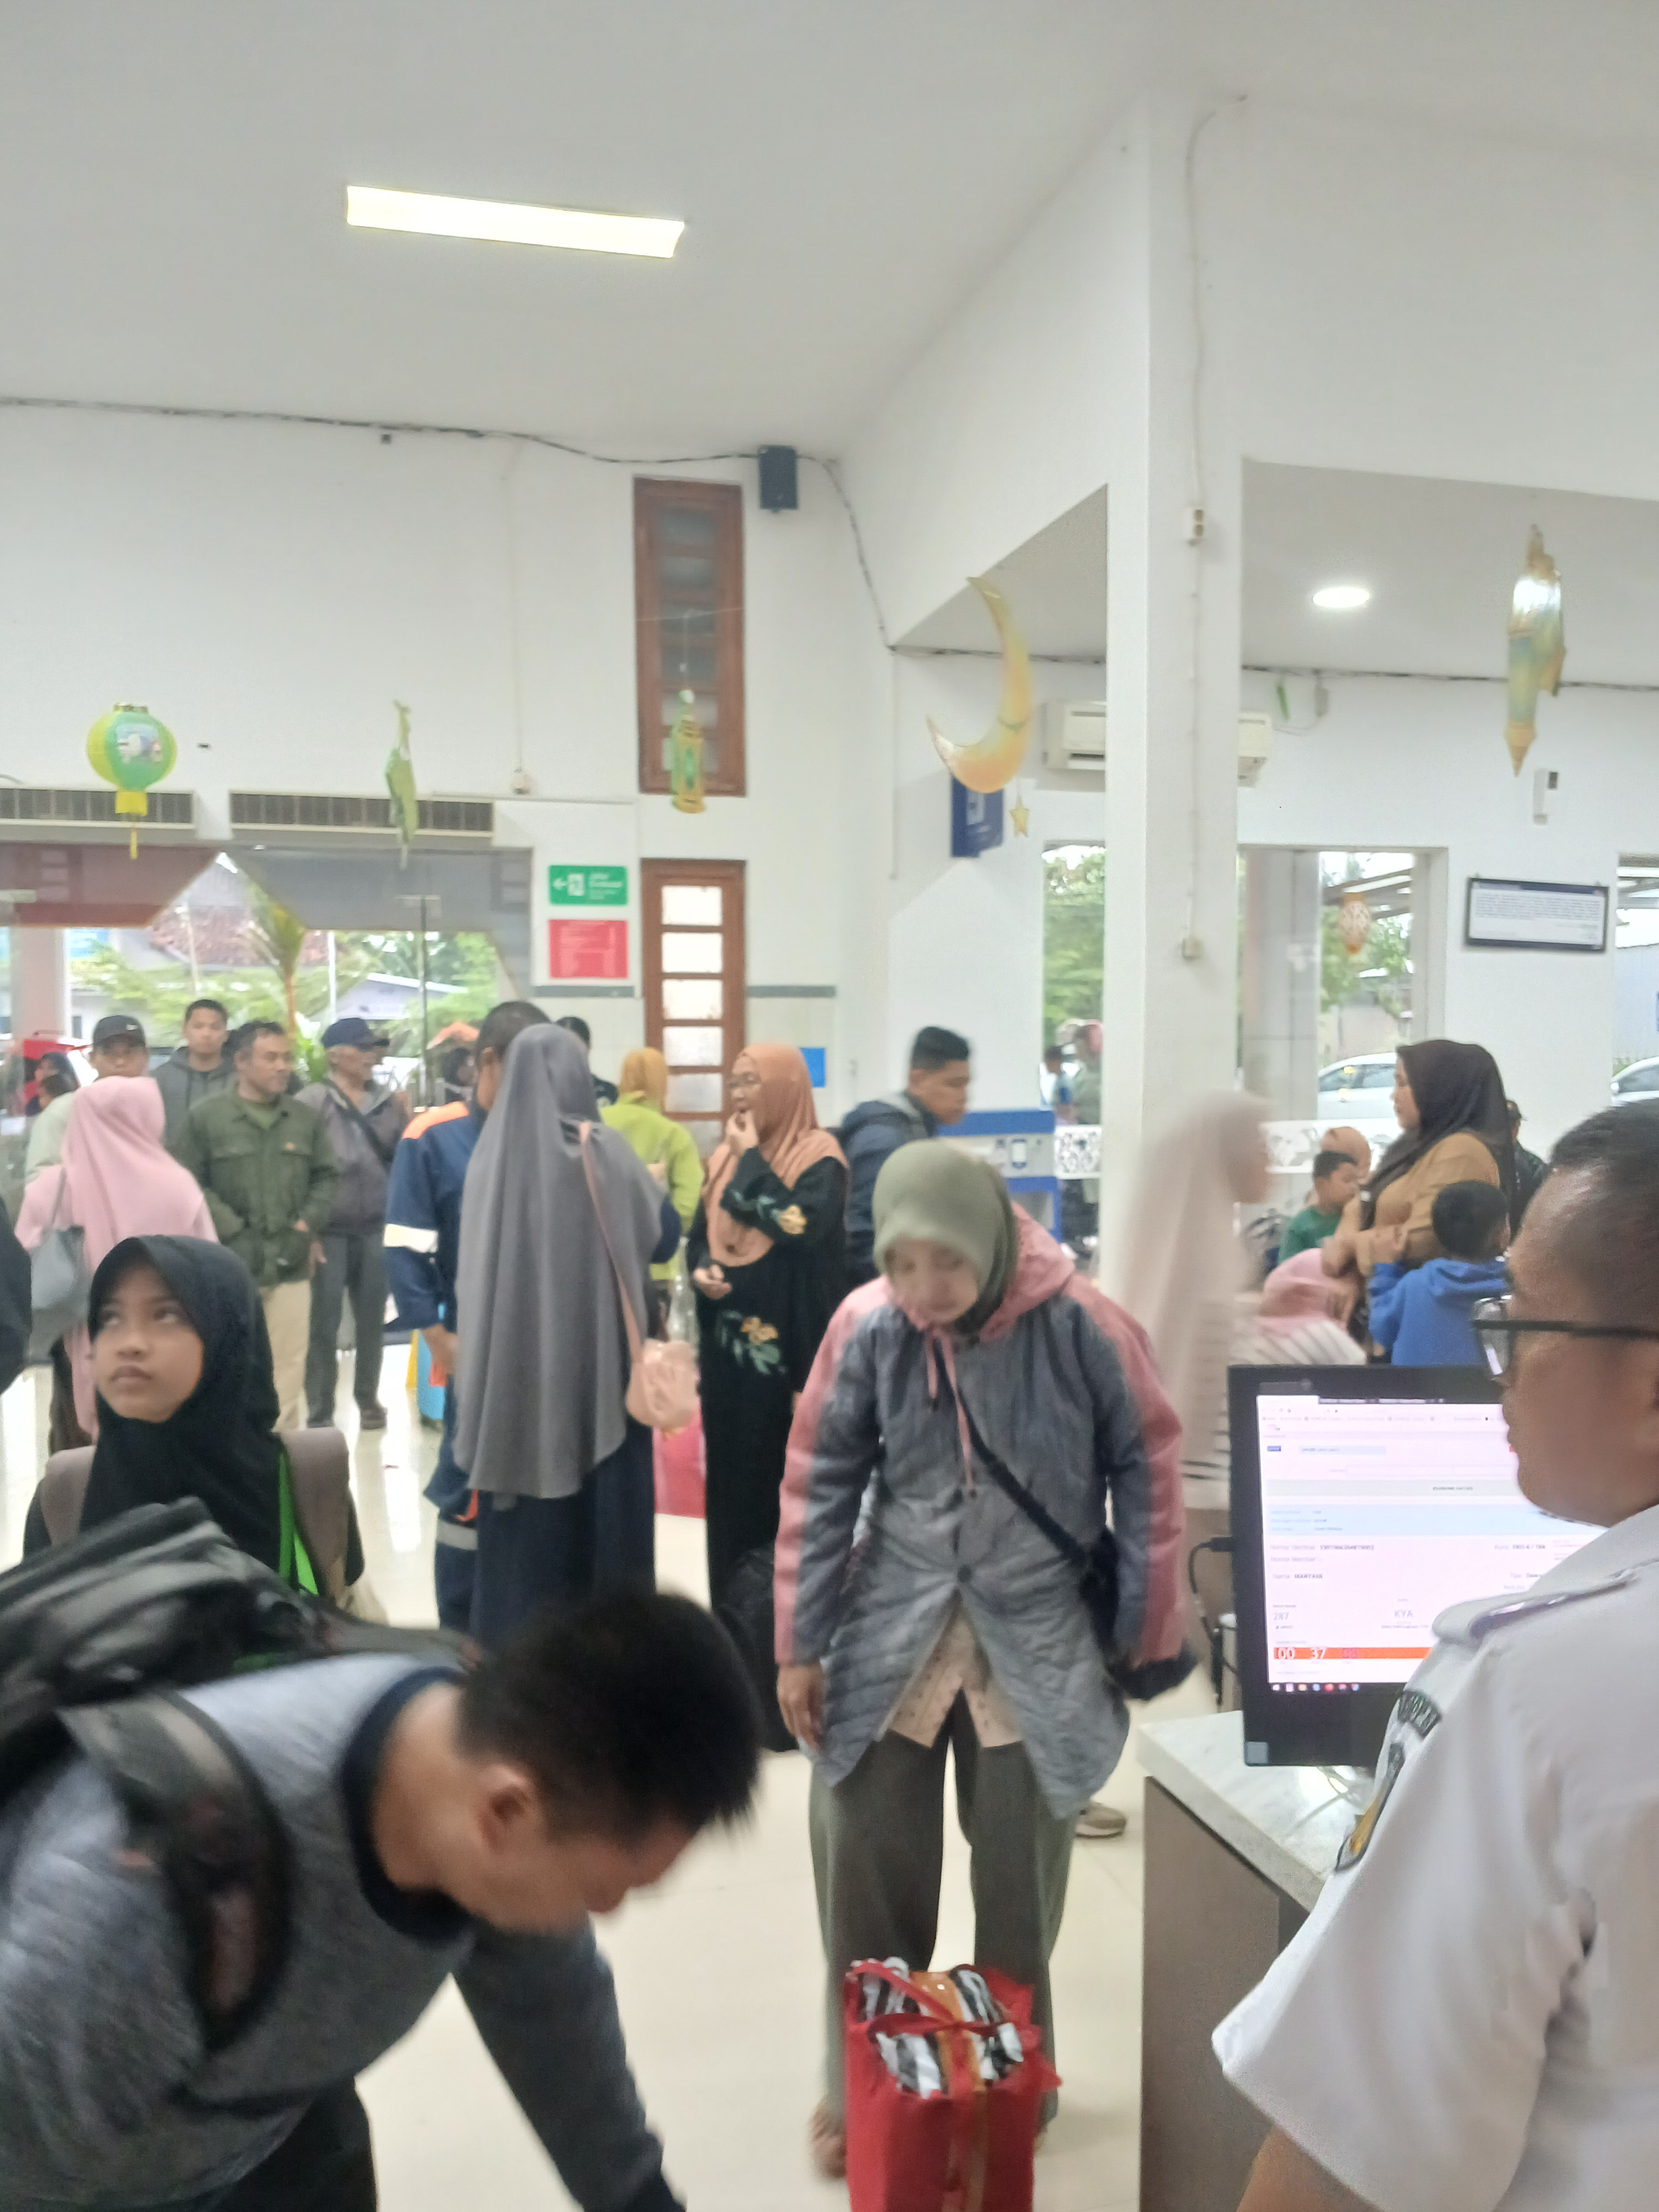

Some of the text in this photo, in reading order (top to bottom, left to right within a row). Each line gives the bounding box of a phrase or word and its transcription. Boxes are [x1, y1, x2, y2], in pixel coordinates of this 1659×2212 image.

[1273, 1612, 1289, 1621] 287
[1394, 1609, 1413, 1618] KYA
[1277, 1647, 1296, 1660] 00
[1310, 1647, 1327, 1660] 37
